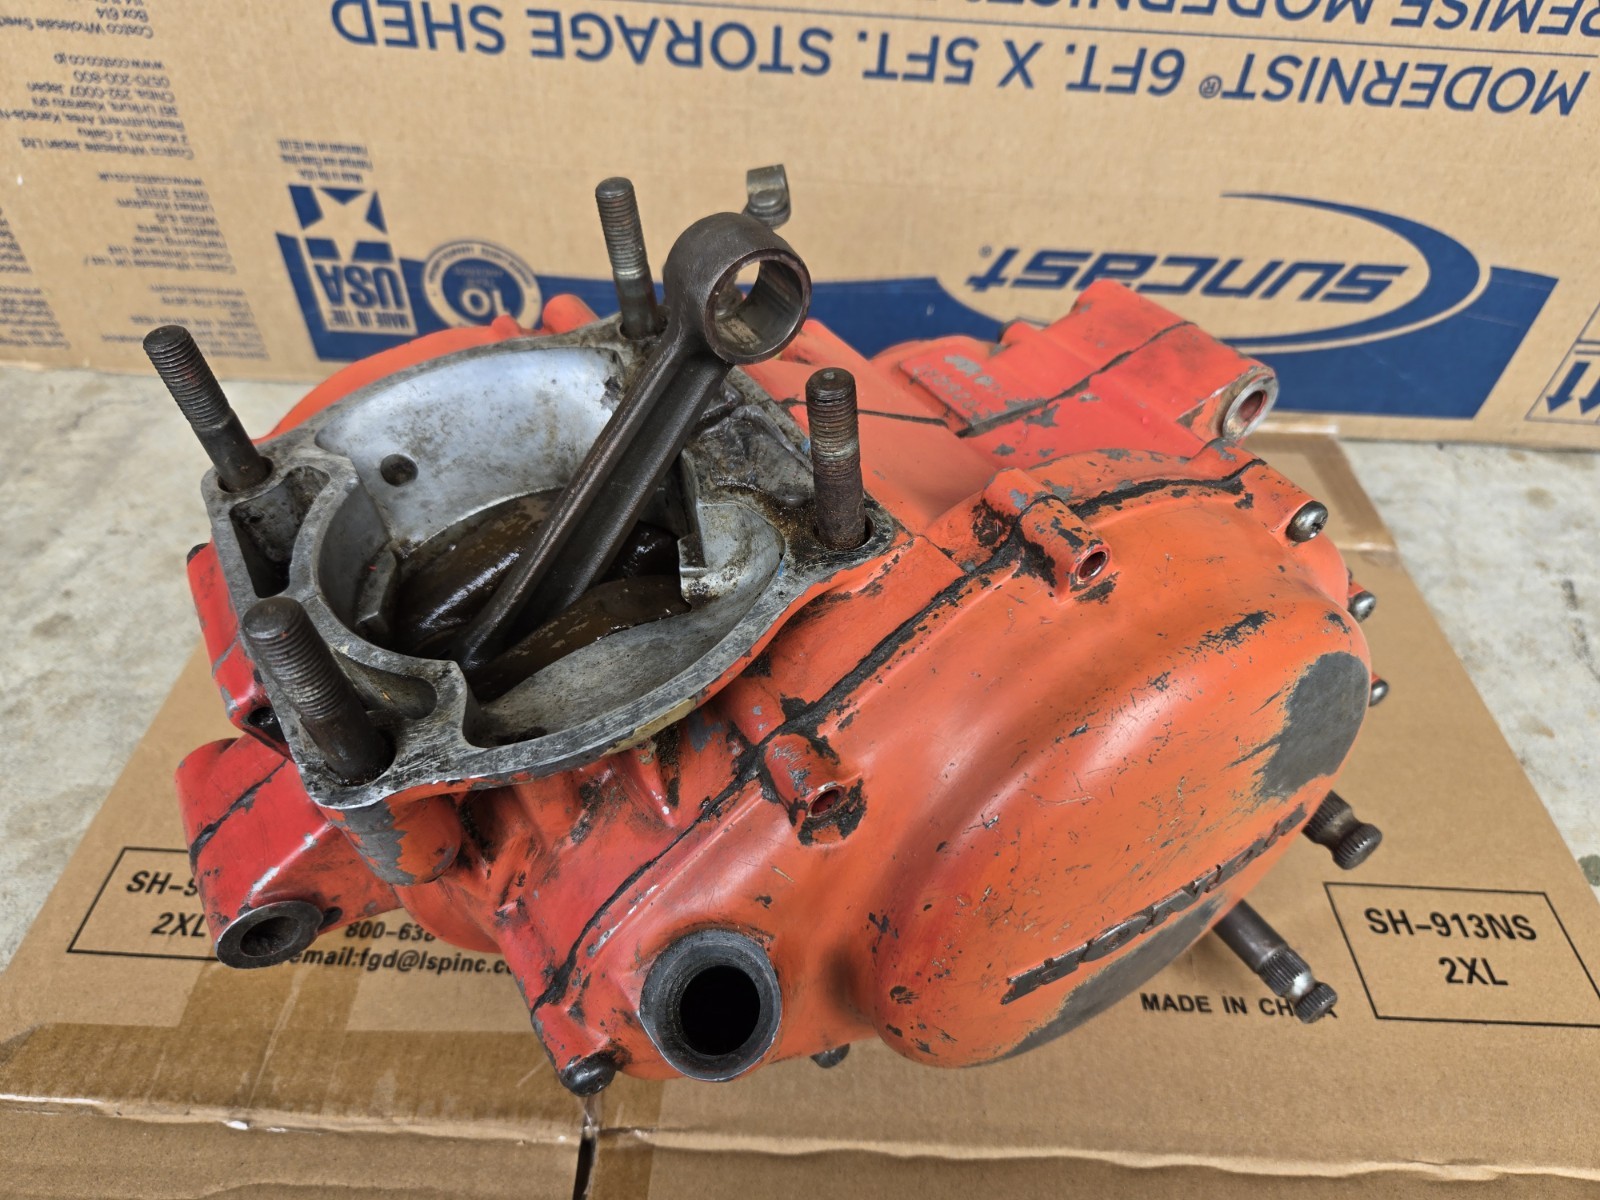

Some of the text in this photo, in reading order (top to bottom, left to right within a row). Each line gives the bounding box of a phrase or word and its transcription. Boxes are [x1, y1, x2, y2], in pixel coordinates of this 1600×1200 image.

[331, 0, 506, 56] SHED
[530, 8, 834, 77] STORAGE
[857, 31, 980, 86] 5FT.
[998, 39, 1043, 90] X
[1064, 43, 1186, 98] 6FT.
[313, 263, 406, 311] USA
[461, 288, 510, 318] 10
[150, 911, 208, 938] 2XL
[1363, 906, 1538, 941] SH-913NS
[1438, 956, 1509, 987] 2XL
[1139, 992, 1212, 1014] MADE
[1222, 995, 1248, 1015] IN
